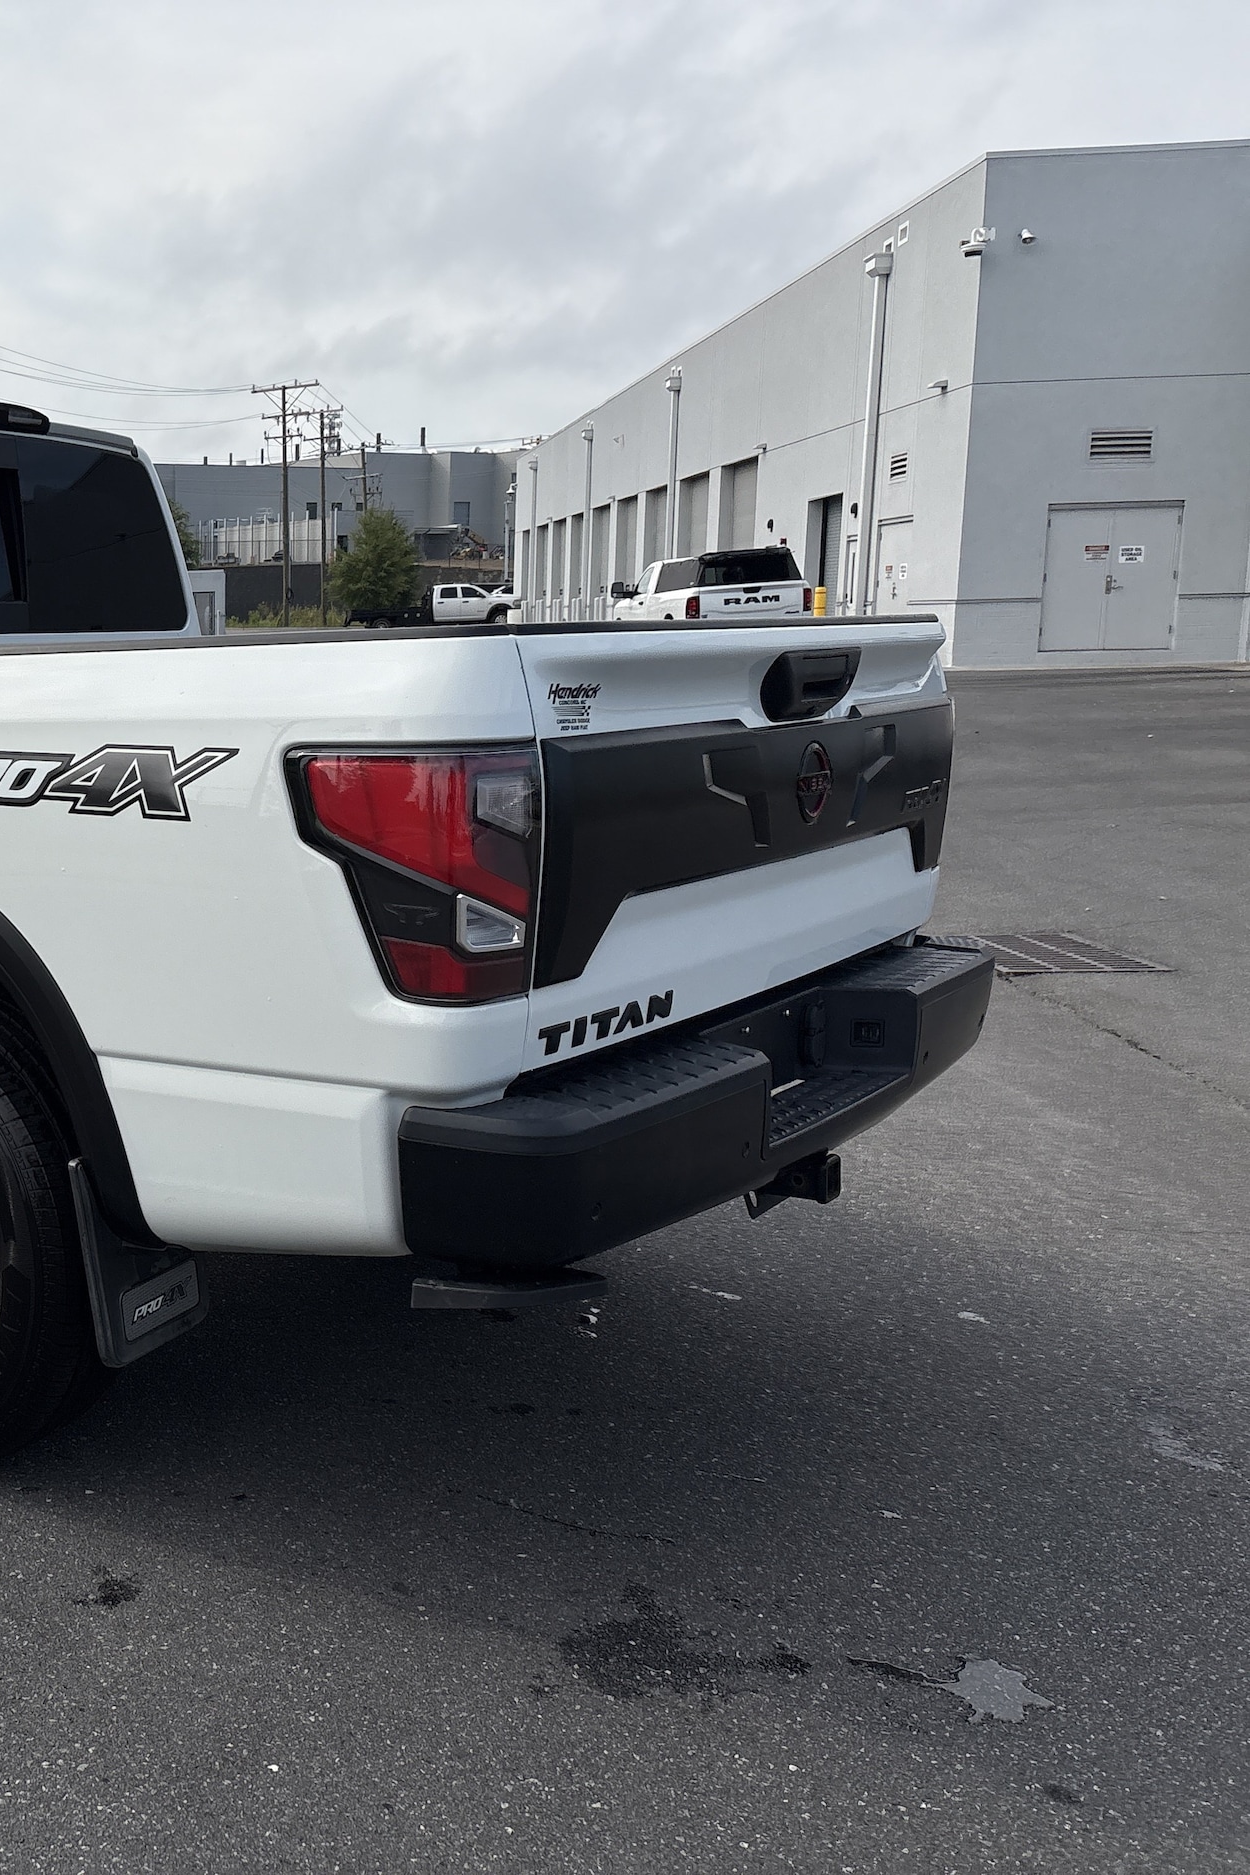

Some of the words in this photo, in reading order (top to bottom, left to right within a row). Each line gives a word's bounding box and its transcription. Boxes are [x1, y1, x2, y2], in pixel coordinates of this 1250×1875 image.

[723, 594, 780, 606] RAM
[547, 683, 602, 705] Hendrick
[537, 989, 674, 1056] TITAN
